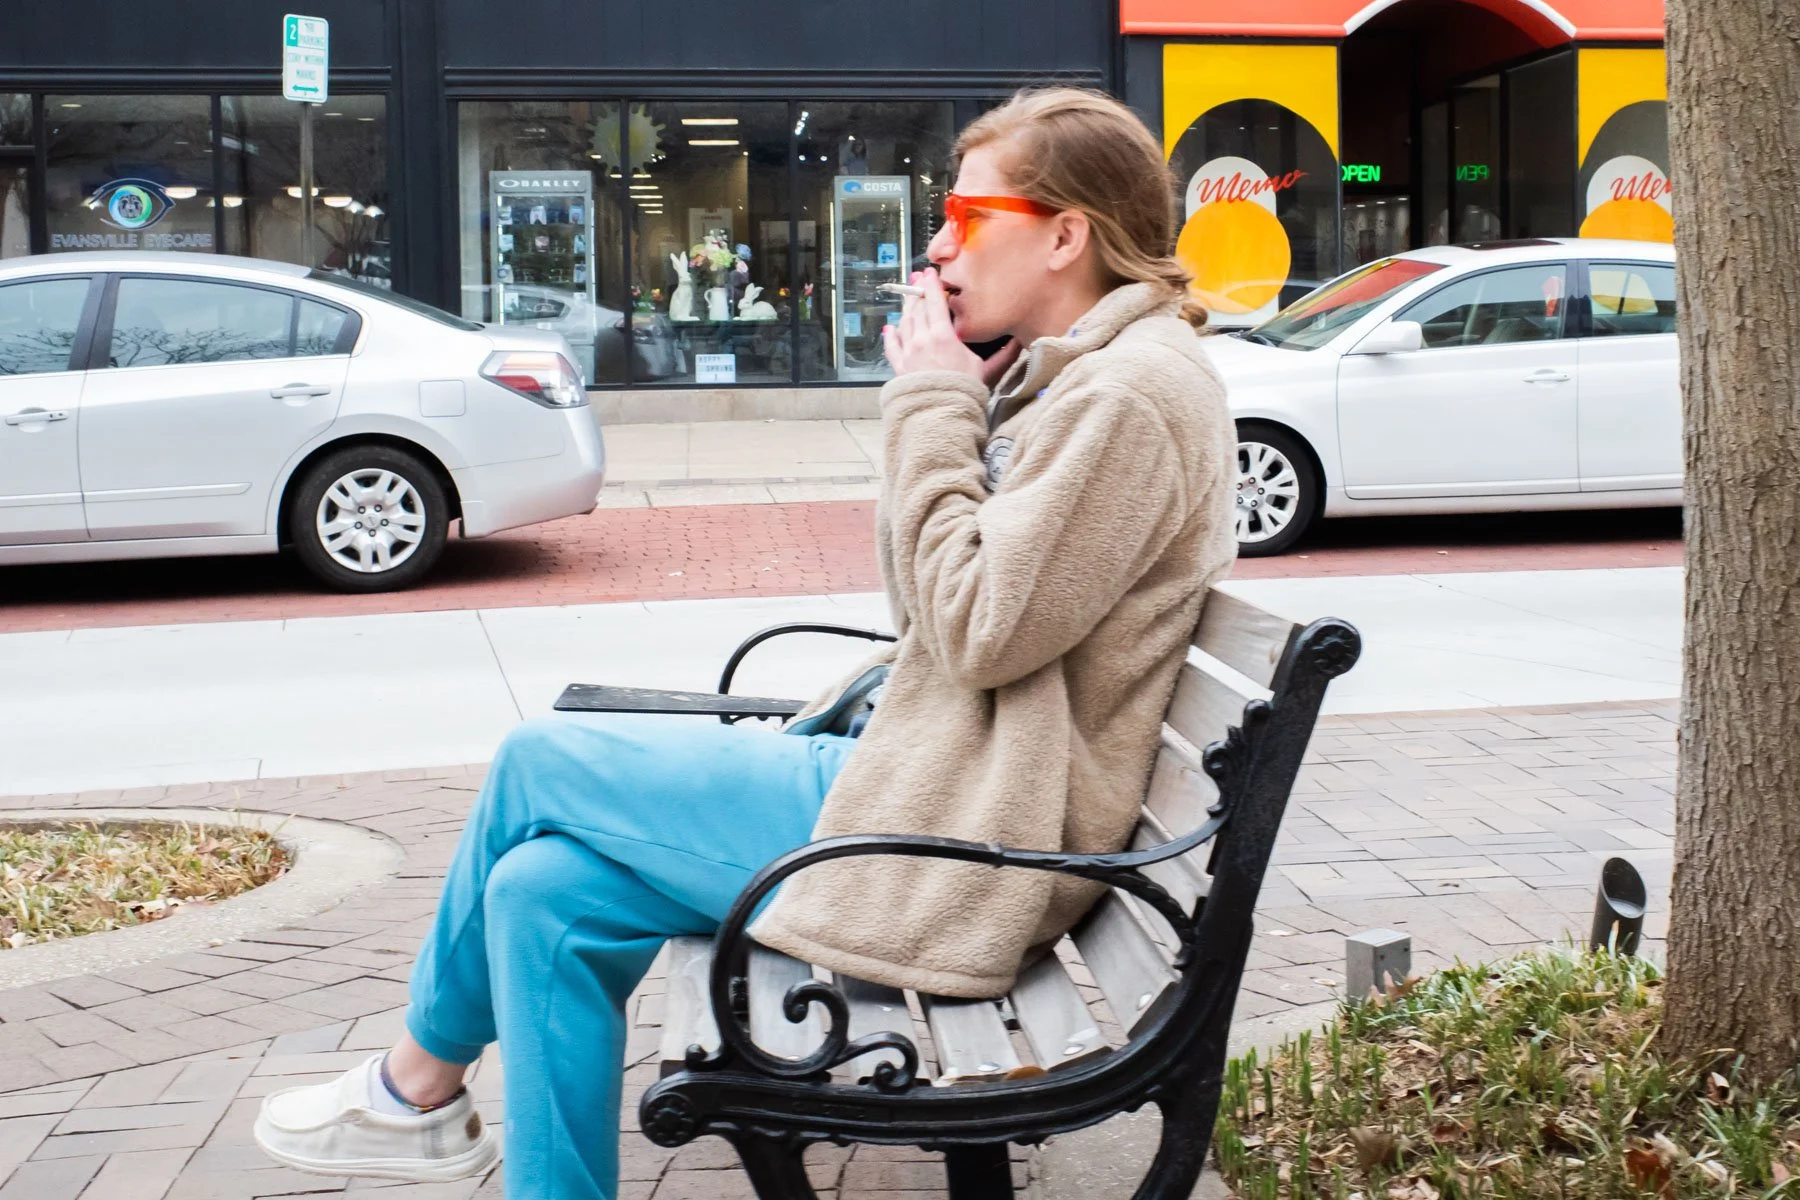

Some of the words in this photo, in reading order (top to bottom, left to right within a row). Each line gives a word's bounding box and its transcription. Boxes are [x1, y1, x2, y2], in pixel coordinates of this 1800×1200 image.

[289, 24, 297, 40] 2
[863, 182, 902, 192] COSTA
[1197, 169, 1308, 204] Memo
[51, 233, 138, 248] EVANSVILLE
[144, 233, 213, 248] EYECARE
